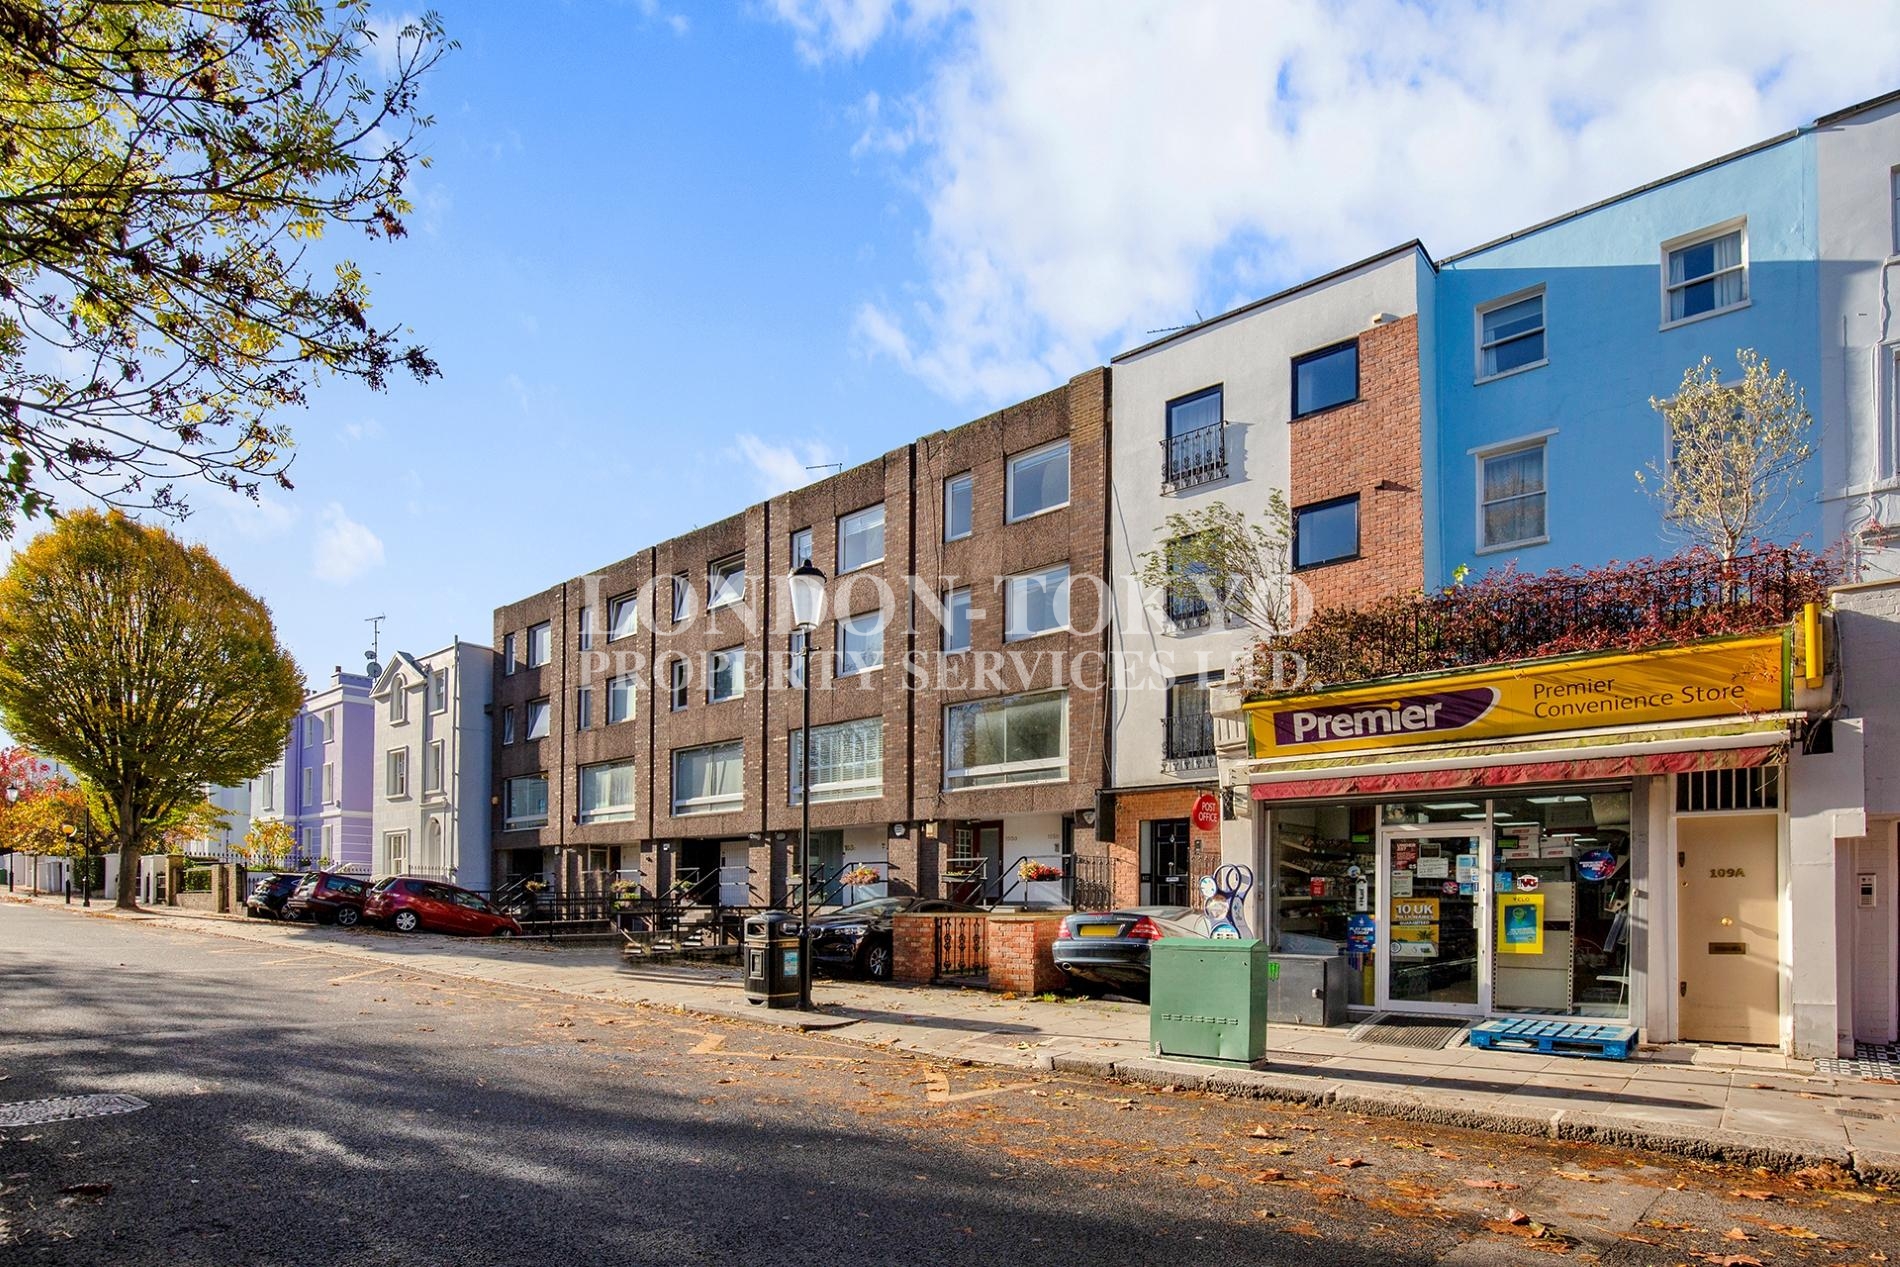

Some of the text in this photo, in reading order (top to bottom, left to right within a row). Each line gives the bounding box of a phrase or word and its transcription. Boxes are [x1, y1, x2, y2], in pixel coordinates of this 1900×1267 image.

[1534, 678, 1615, 700] Premier
[1534, 684, 1745, 719] Convenience Store
[1293, 701, 1442, 742] Premier
[1201, 801, 1216, 812] POST
[1198, 811, 1218, 823] OFFICE
[1709, 867, 1746, 878] 109A
[1396, 904, 1433, 915] 10 UK
